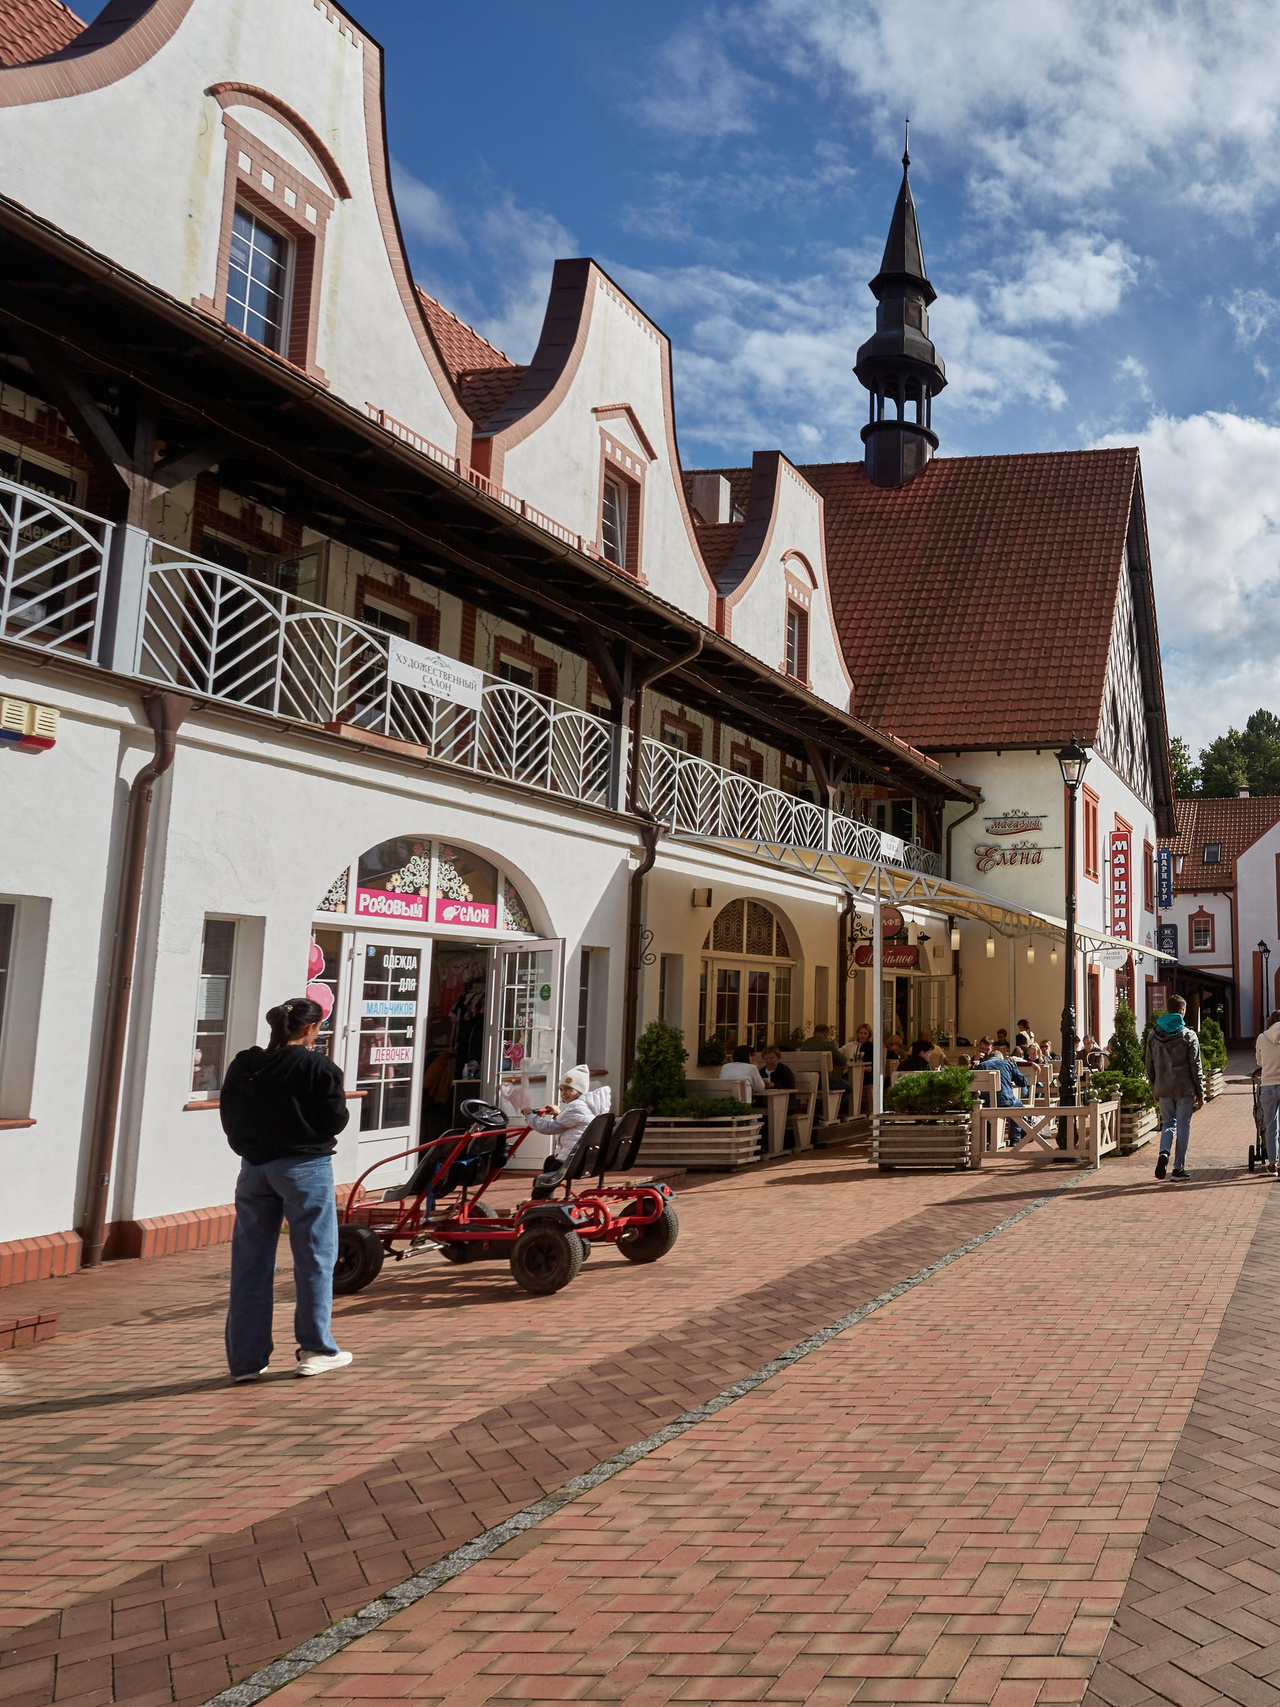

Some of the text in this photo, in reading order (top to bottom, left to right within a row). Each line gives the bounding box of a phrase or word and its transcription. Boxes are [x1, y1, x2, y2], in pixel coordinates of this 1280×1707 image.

[395, 653, 477, 692] ХУДОЖЕСТВЕННЫЙ
[422, 675, 452, 692] САЛОН
[974, 845, 1042, 874] Елена
[1160, 853, 1169, 880] ПАРИ
[383, 954, 417, 970] ОДЕЖДА
[860, 949, 914, 965] Лбимое
[398, 978, 416, 992] ДЛЯ
[366, 1002, 414, 1015] МАЛЬЧИКОВ
[406, 1025, 413, 1038] И
[374, 1048, 410, 1062] ДЕВОЧЕК
